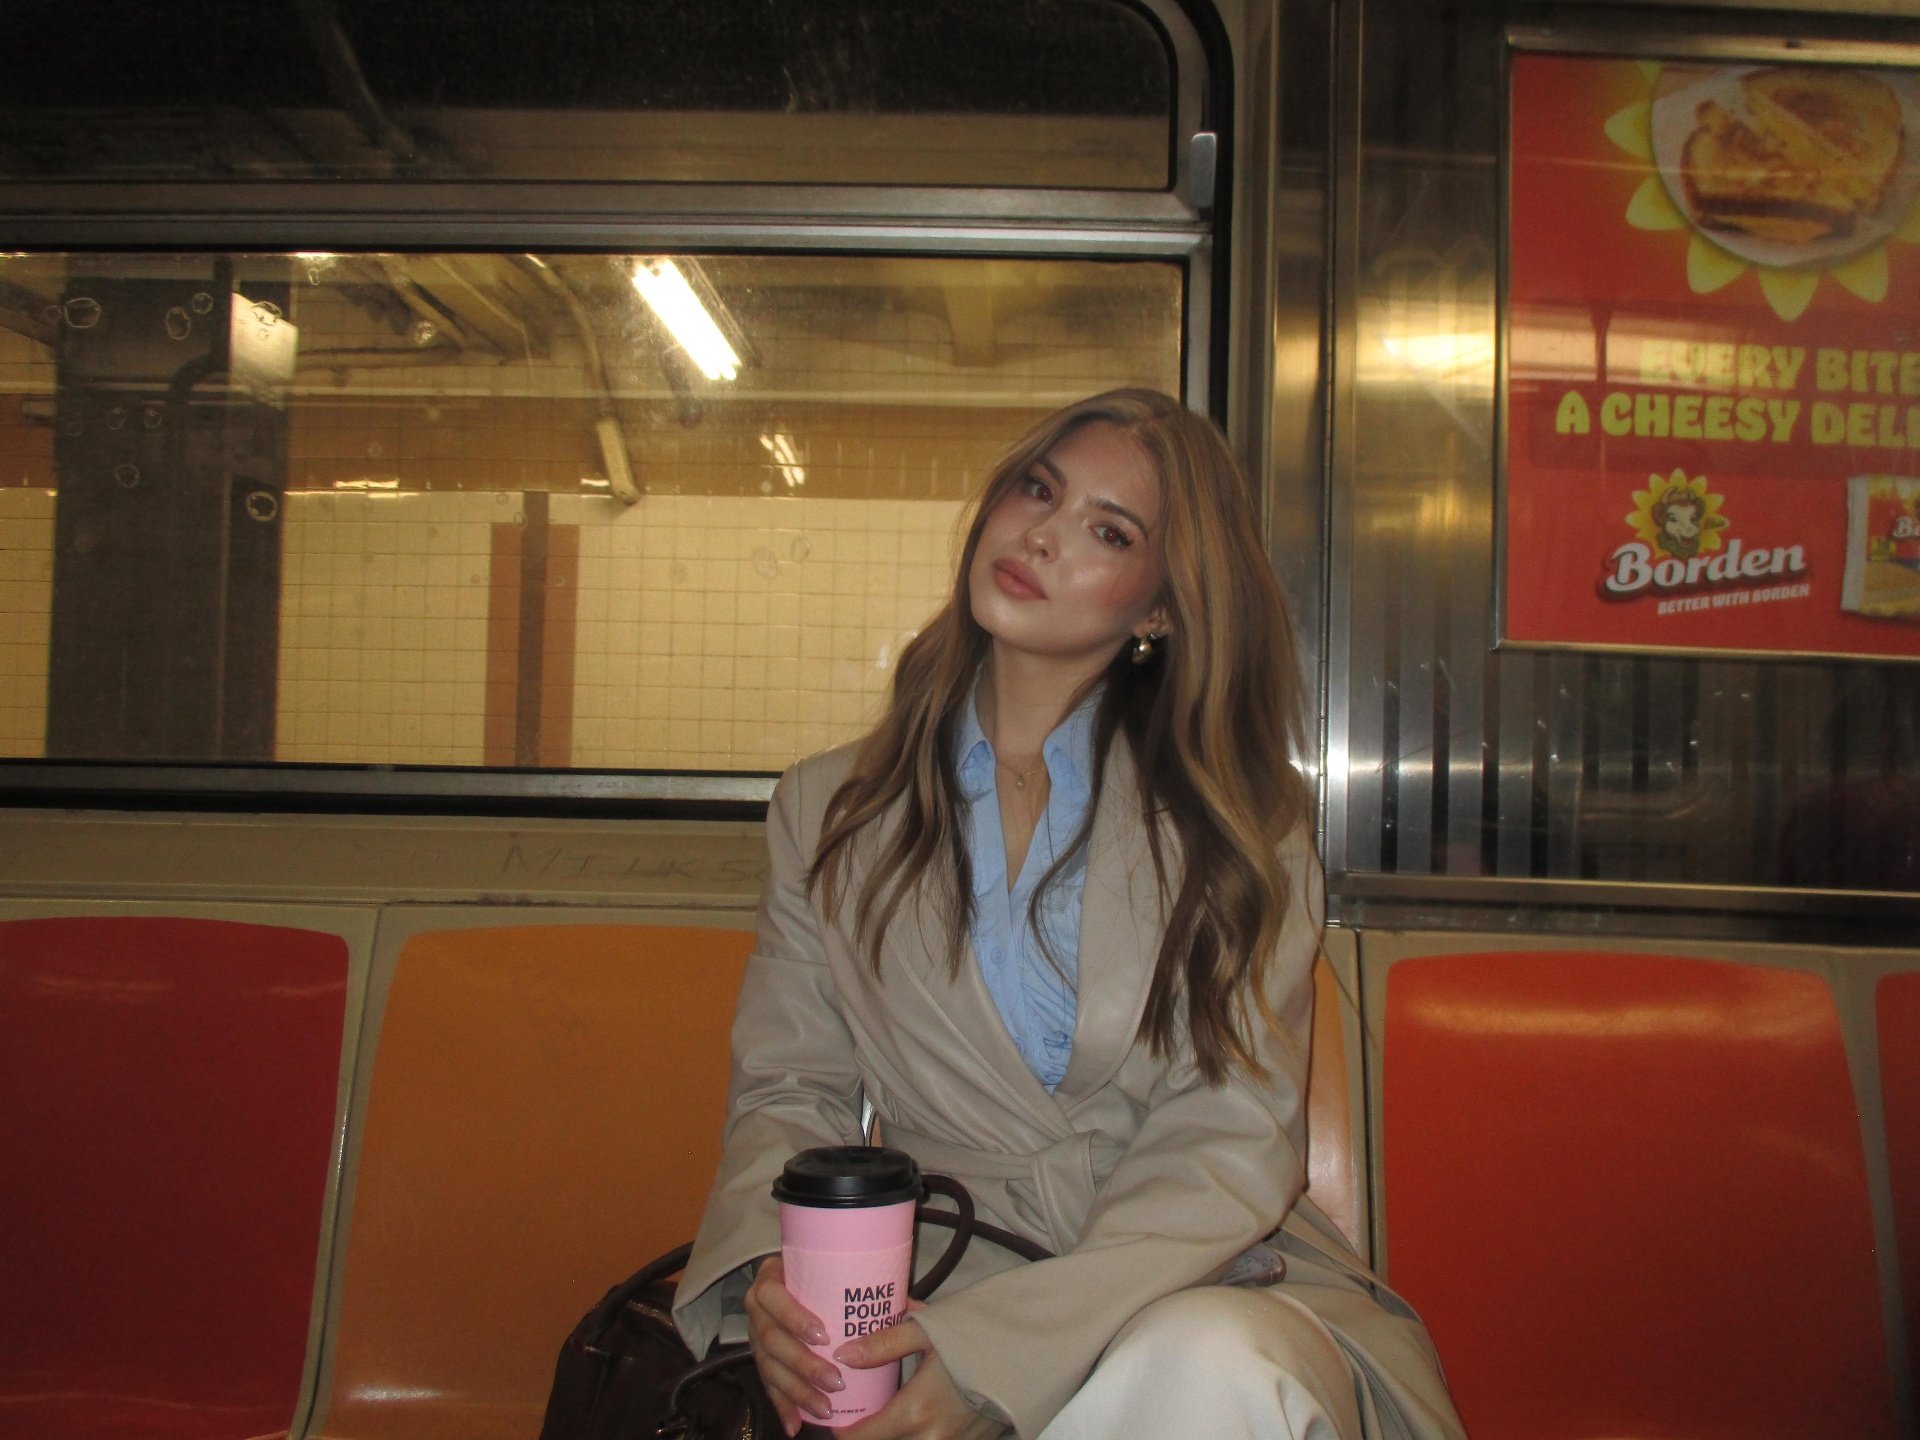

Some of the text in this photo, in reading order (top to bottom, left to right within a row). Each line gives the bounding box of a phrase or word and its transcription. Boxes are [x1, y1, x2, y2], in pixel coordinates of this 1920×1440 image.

[1640, 340, 1806, 389] EVERY
[1555, 390, 1590, 435] A
[1600, 392, 1801, 443] CHEESY
[1606, 539, 1806, 593] Borden
[1657, 583, 1810, 615] BETTER WITH BORDEN
[844, 1282, 895, 1303] MAKE
[844, 1300, 892, 1320] POUR
